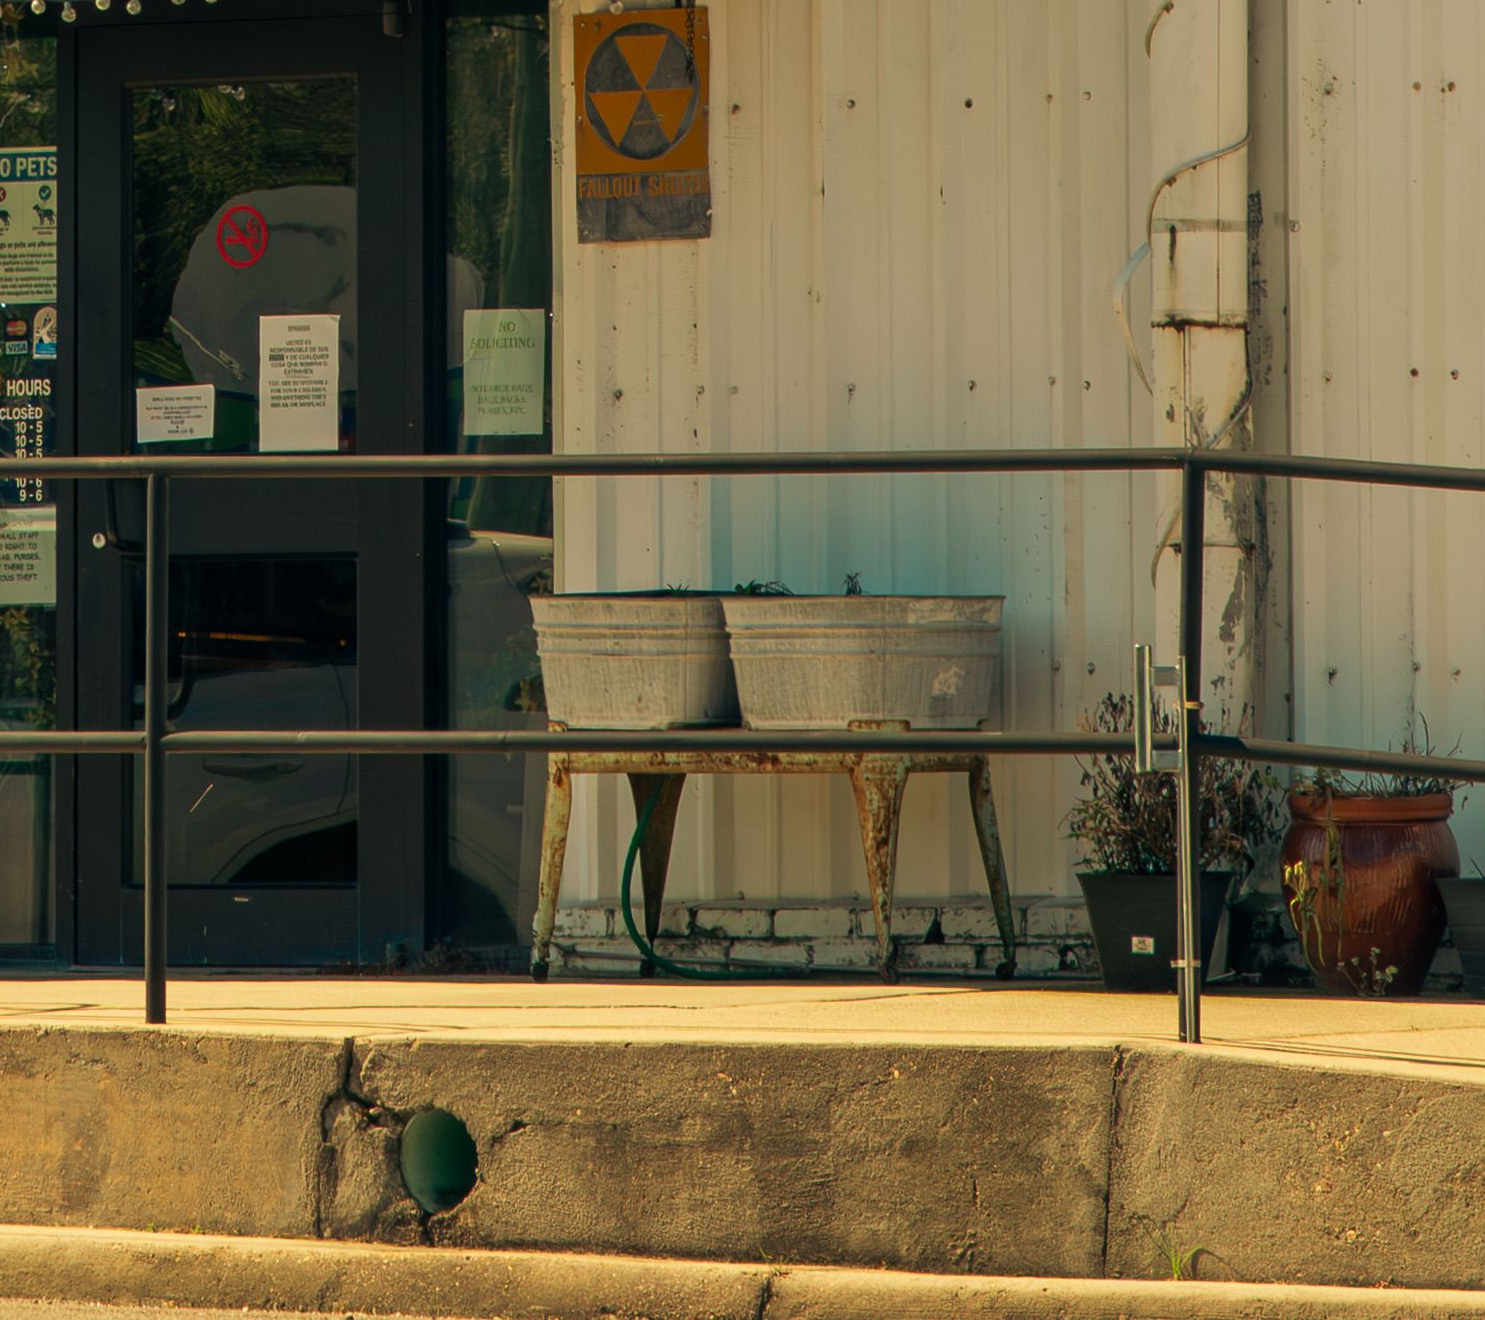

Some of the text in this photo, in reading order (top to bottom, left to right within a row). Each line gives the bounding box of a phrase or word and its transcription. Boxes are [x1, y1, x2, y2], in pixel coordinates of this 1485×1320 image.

[16, 156, 57, 178] PETS
[578, 175, 641, 198] FALLOUT
[498, 322, 516, 333] NO
[8, 343, 28, 353] VISA
[470, 337, 535, 349] SOLICITING
[7, 379, 51, 397] HOURS
[15, 422, 27, 434] 10
[15, 436, 27, 447] 10
[19, 490, 27, 502] 9
